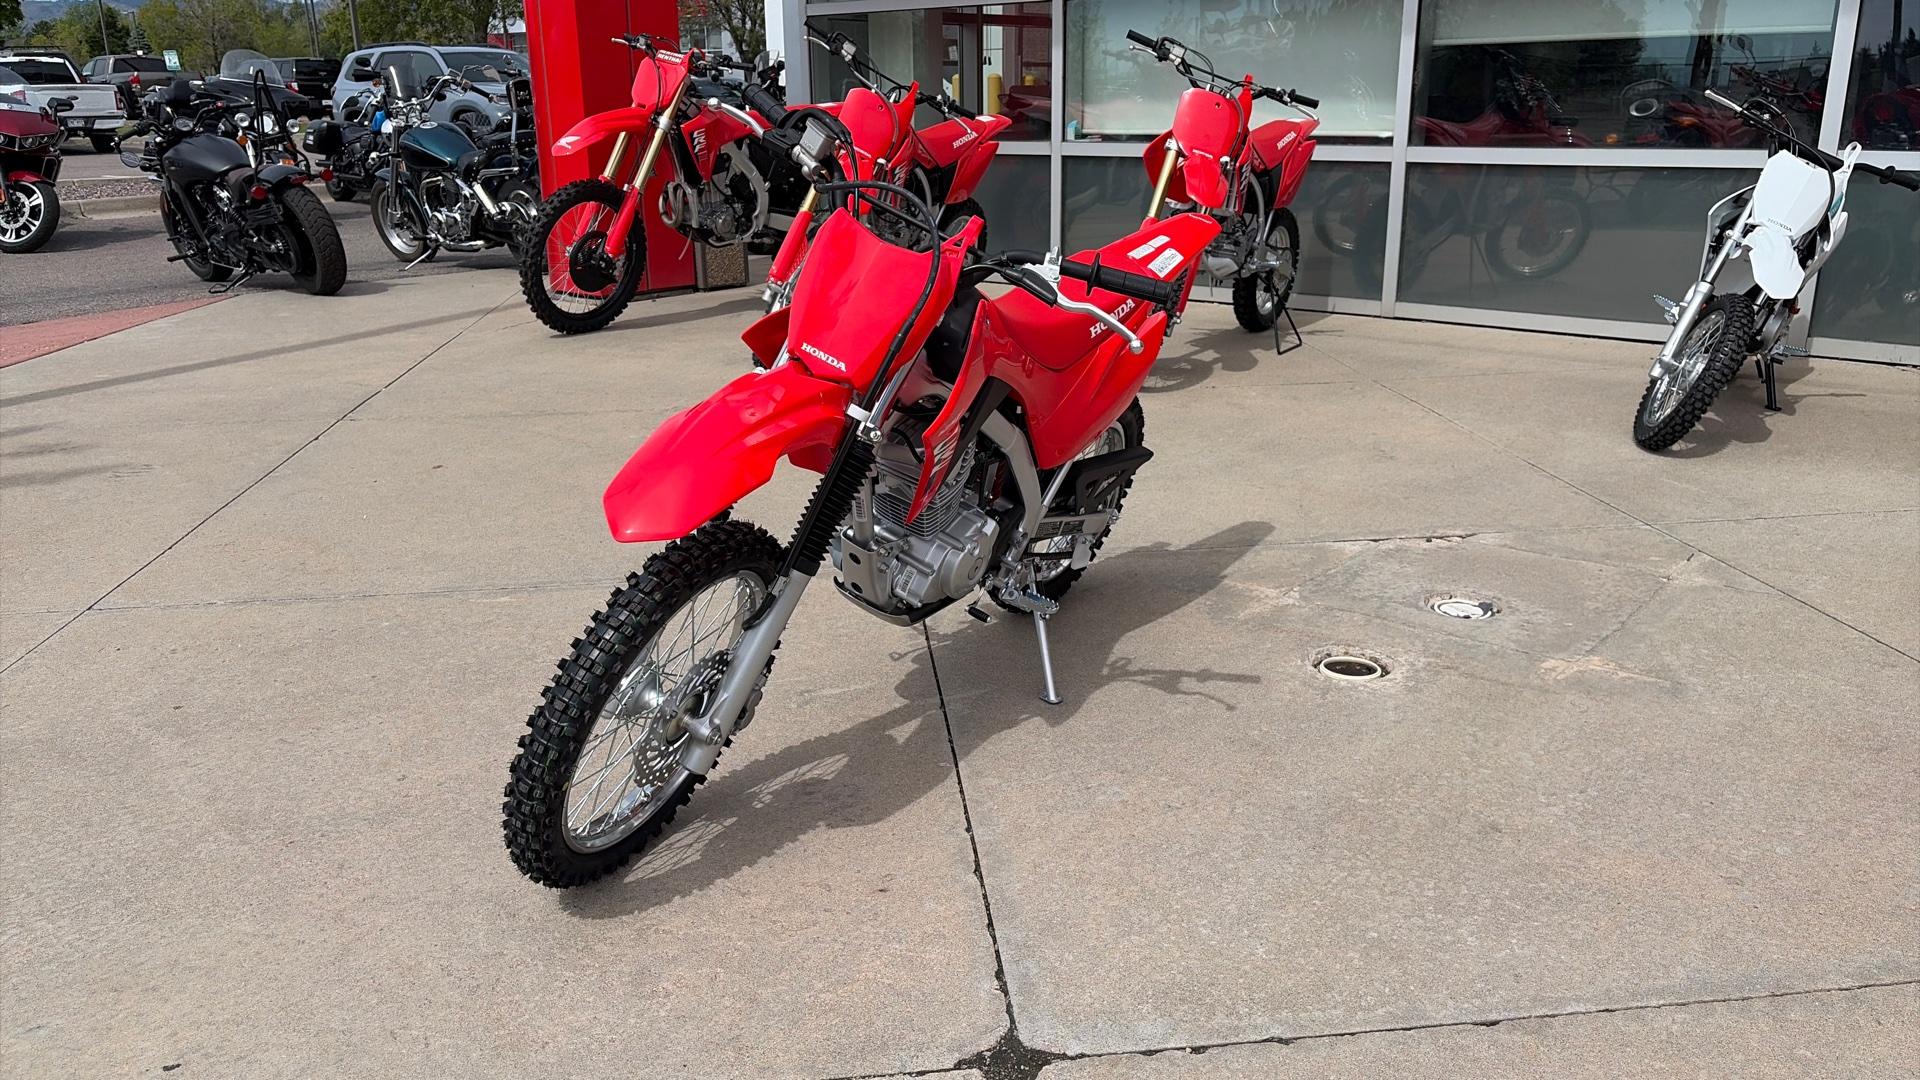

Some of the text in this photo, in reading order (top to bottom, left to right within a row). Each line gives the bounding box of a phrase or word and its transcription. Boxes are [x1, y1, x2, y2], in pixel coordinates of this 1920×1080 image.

[952, 131, 978, 149] HONDA
[1276, 131, 1297, 150] HONDA
[1767, 218, 1792, 232] HONDA
[800, 341, 847, 373] HONDA
